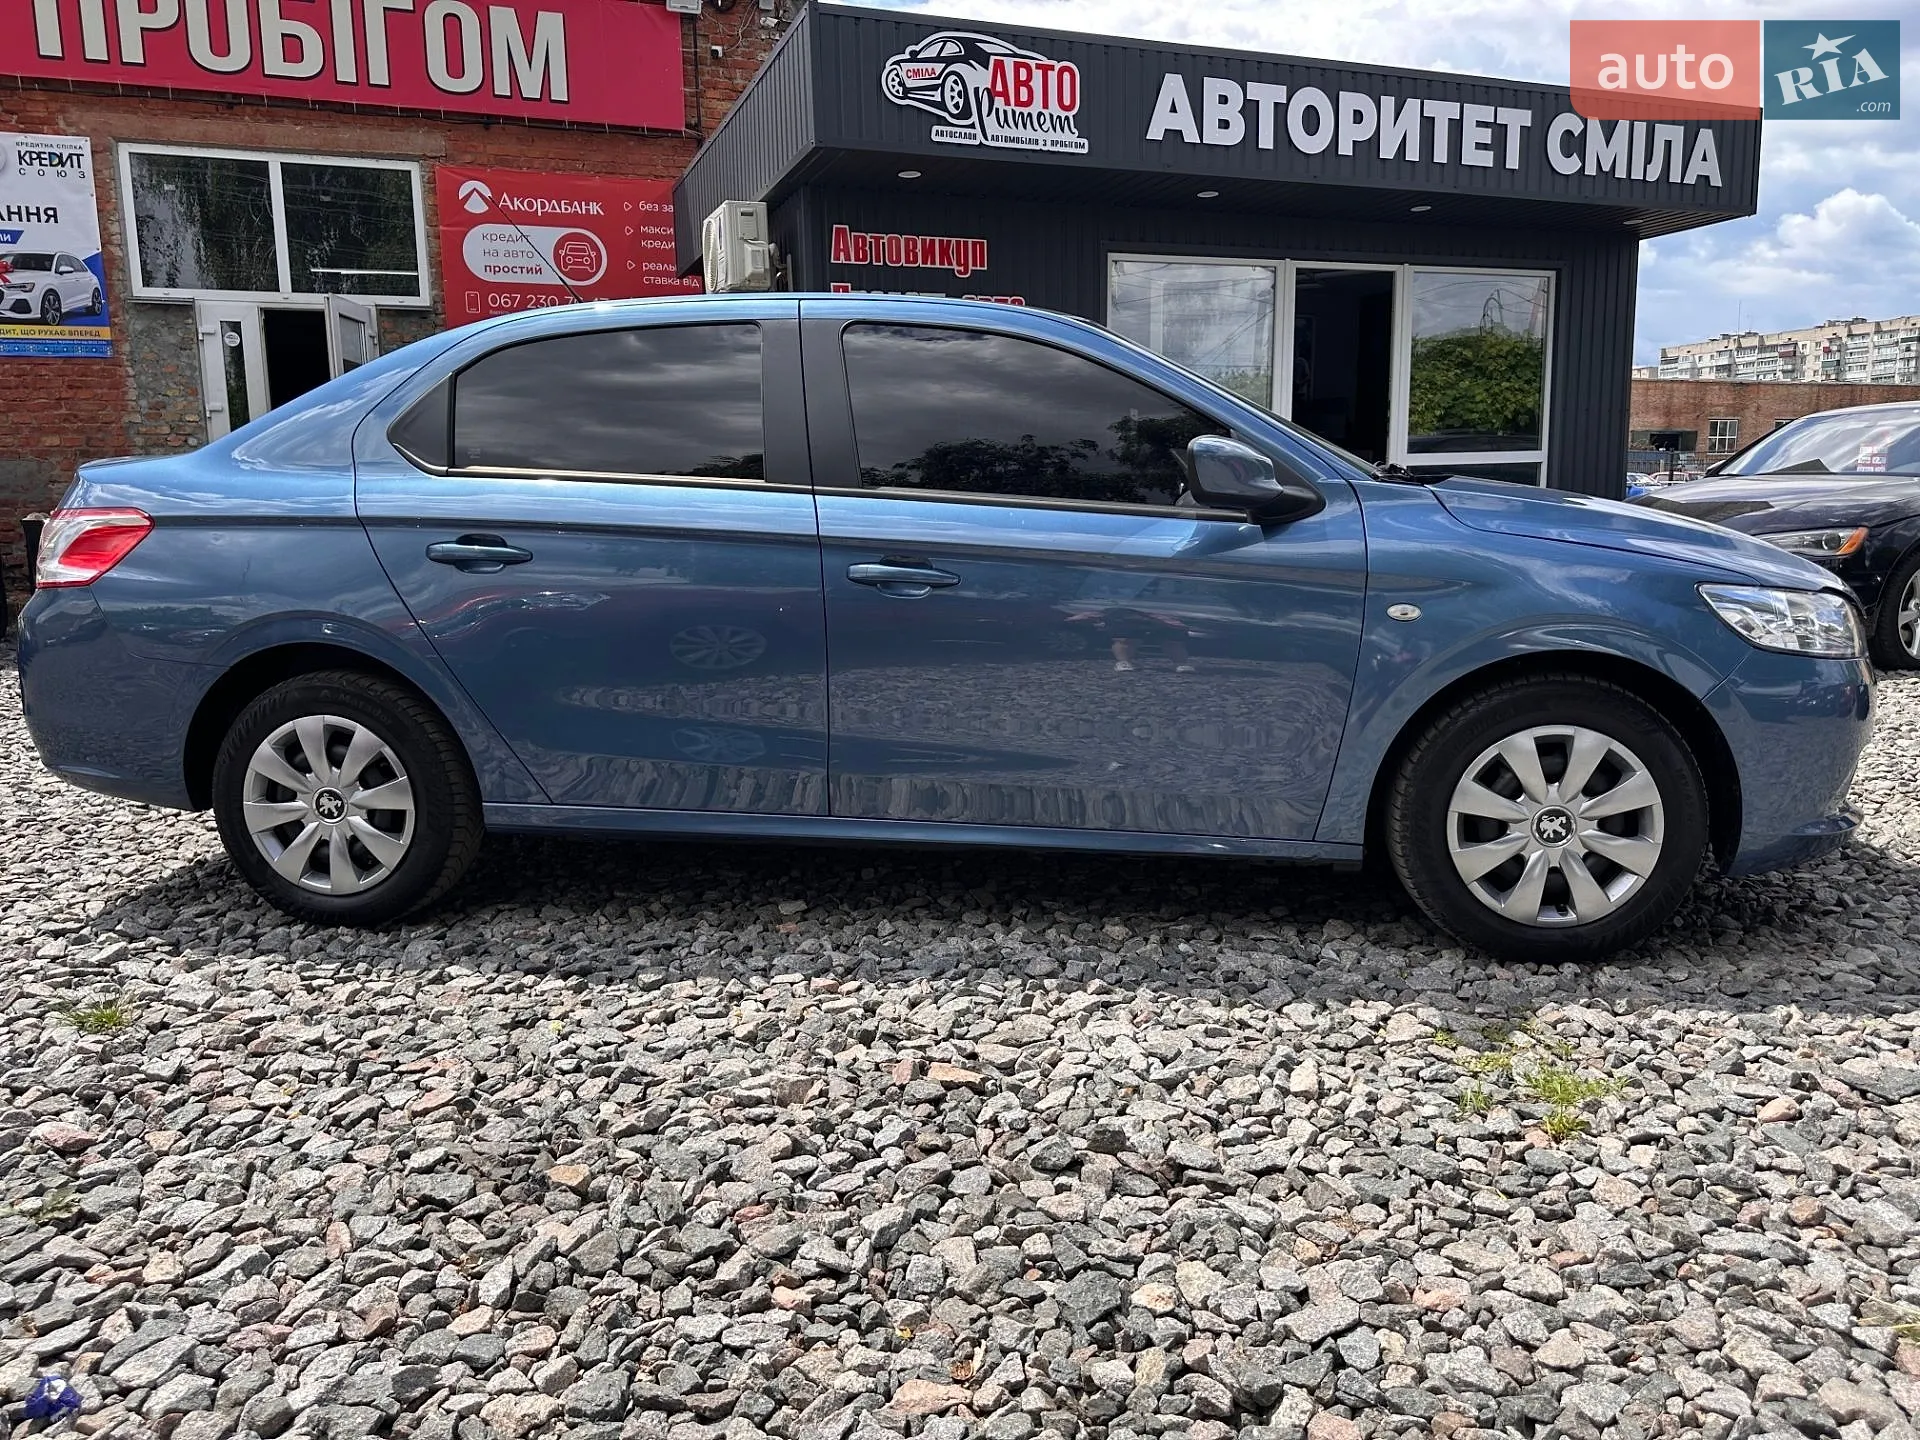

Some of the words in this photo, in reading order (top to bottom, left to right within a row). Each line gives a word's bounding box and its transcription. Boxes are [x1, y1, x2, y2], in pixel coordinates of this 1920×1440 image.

[32, 0, 570, 104] ПРОБІГОМ
[905, 66, 938, 80] СМІЛА
[989, 58, 1077, 113] АВТО
[934, 128, 977, 142] АВТОСАЛОН
[1145, 73, 1532, 171] АВТОРИТЕТ
[1546, 113, 1723, 188] СМІЛА
[15, 141, 54, 149] КРЕДИТНА
[990, 134, 1040, 146] АВТОМОБІЛІВ
[1050, 139, 1086, 150] ПРОБІГОМ
[638, 200, 659, 212] без
[640, 225, 674, 236] макси
[481, 232, 531, 244] кредит
[483, 248, 499, 258] на
[503, 250, 535, 260] авто
[484, 262, 543, 276] простий
[642, 261, 679, 273] реаль
[643, 275, 680, 286] ставка
[683, 277, 700, 288] від
[487, 293, 521, 308] 067
[526, 294, 559, 309] 230
